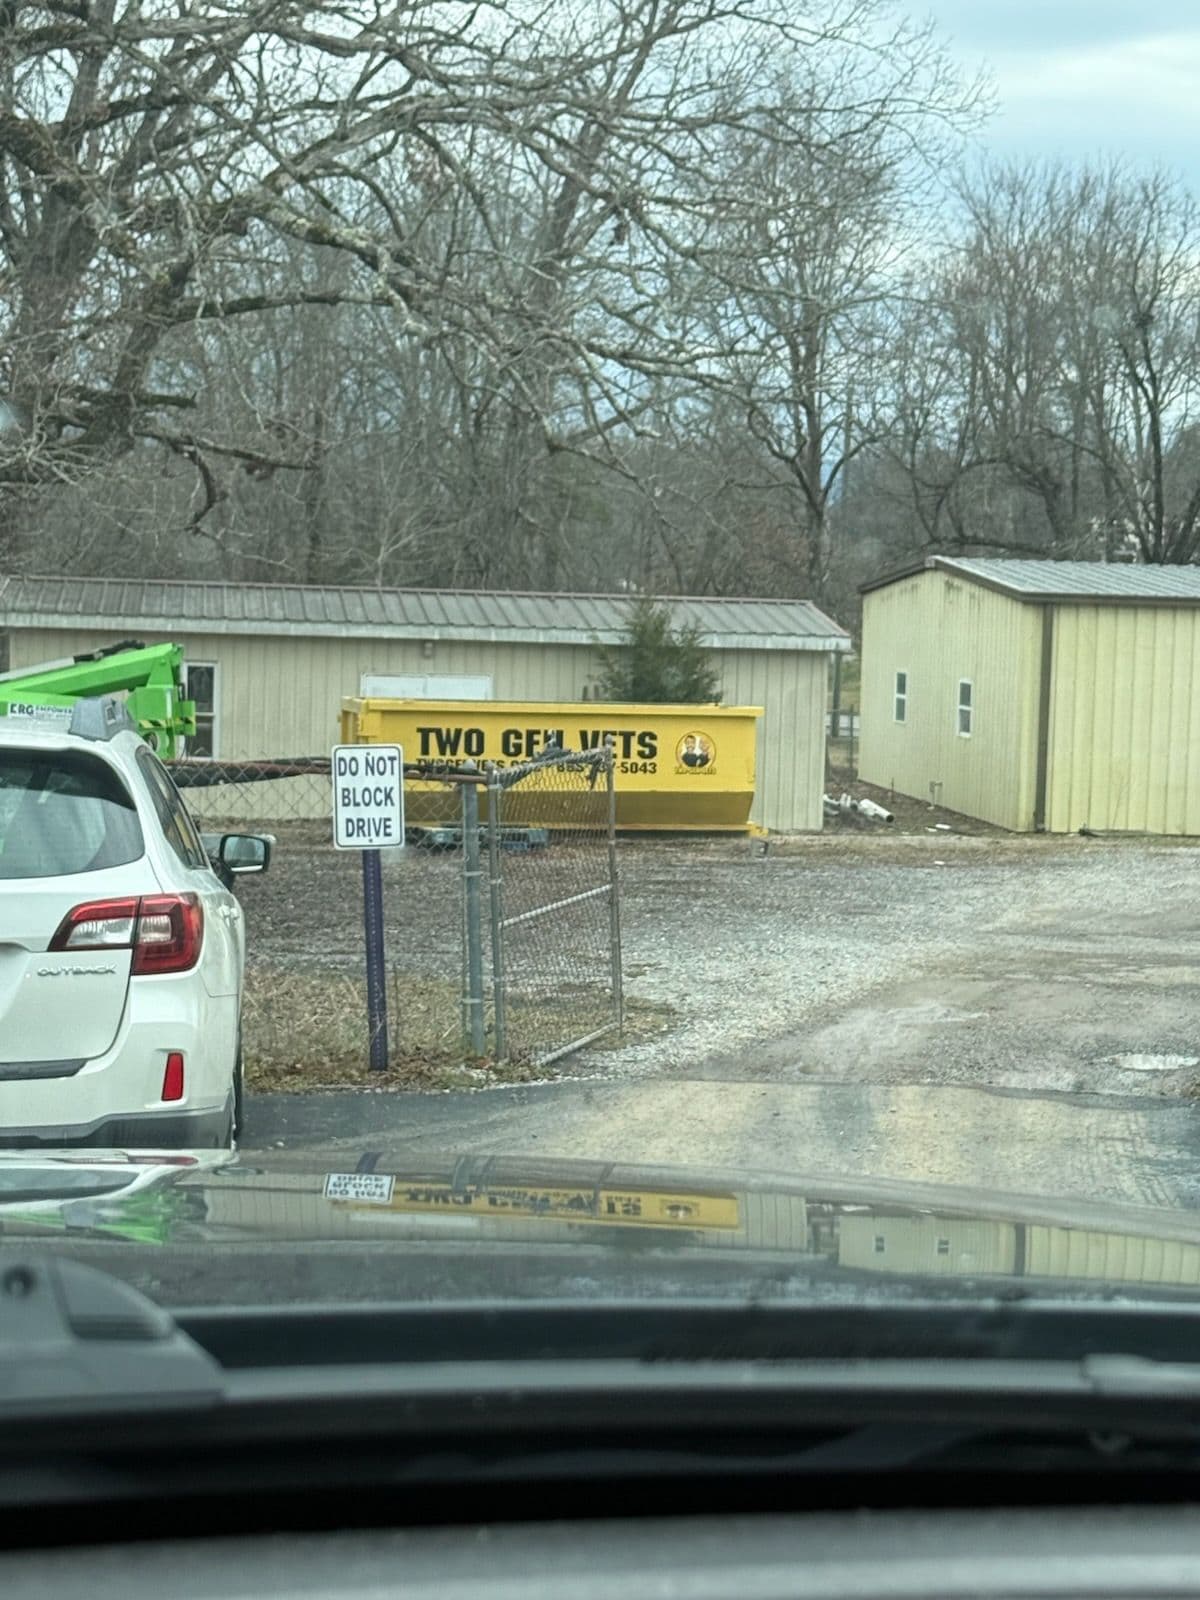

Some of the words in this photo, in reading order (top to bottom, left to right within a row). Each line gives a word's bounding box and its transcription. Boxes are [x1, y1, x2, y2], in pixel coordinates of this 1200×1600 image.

[416, 727, 485, 756] TWO
[580, 729, 658, 760] VETS
[338, 756, 359, 776] DO
[365, 755, 397, 776] NOT
[341, 787, 395, 807] BLOCK
[345, 817, 393, 838] DRIVE
[37, 964, 117, 977] OUTBACK
